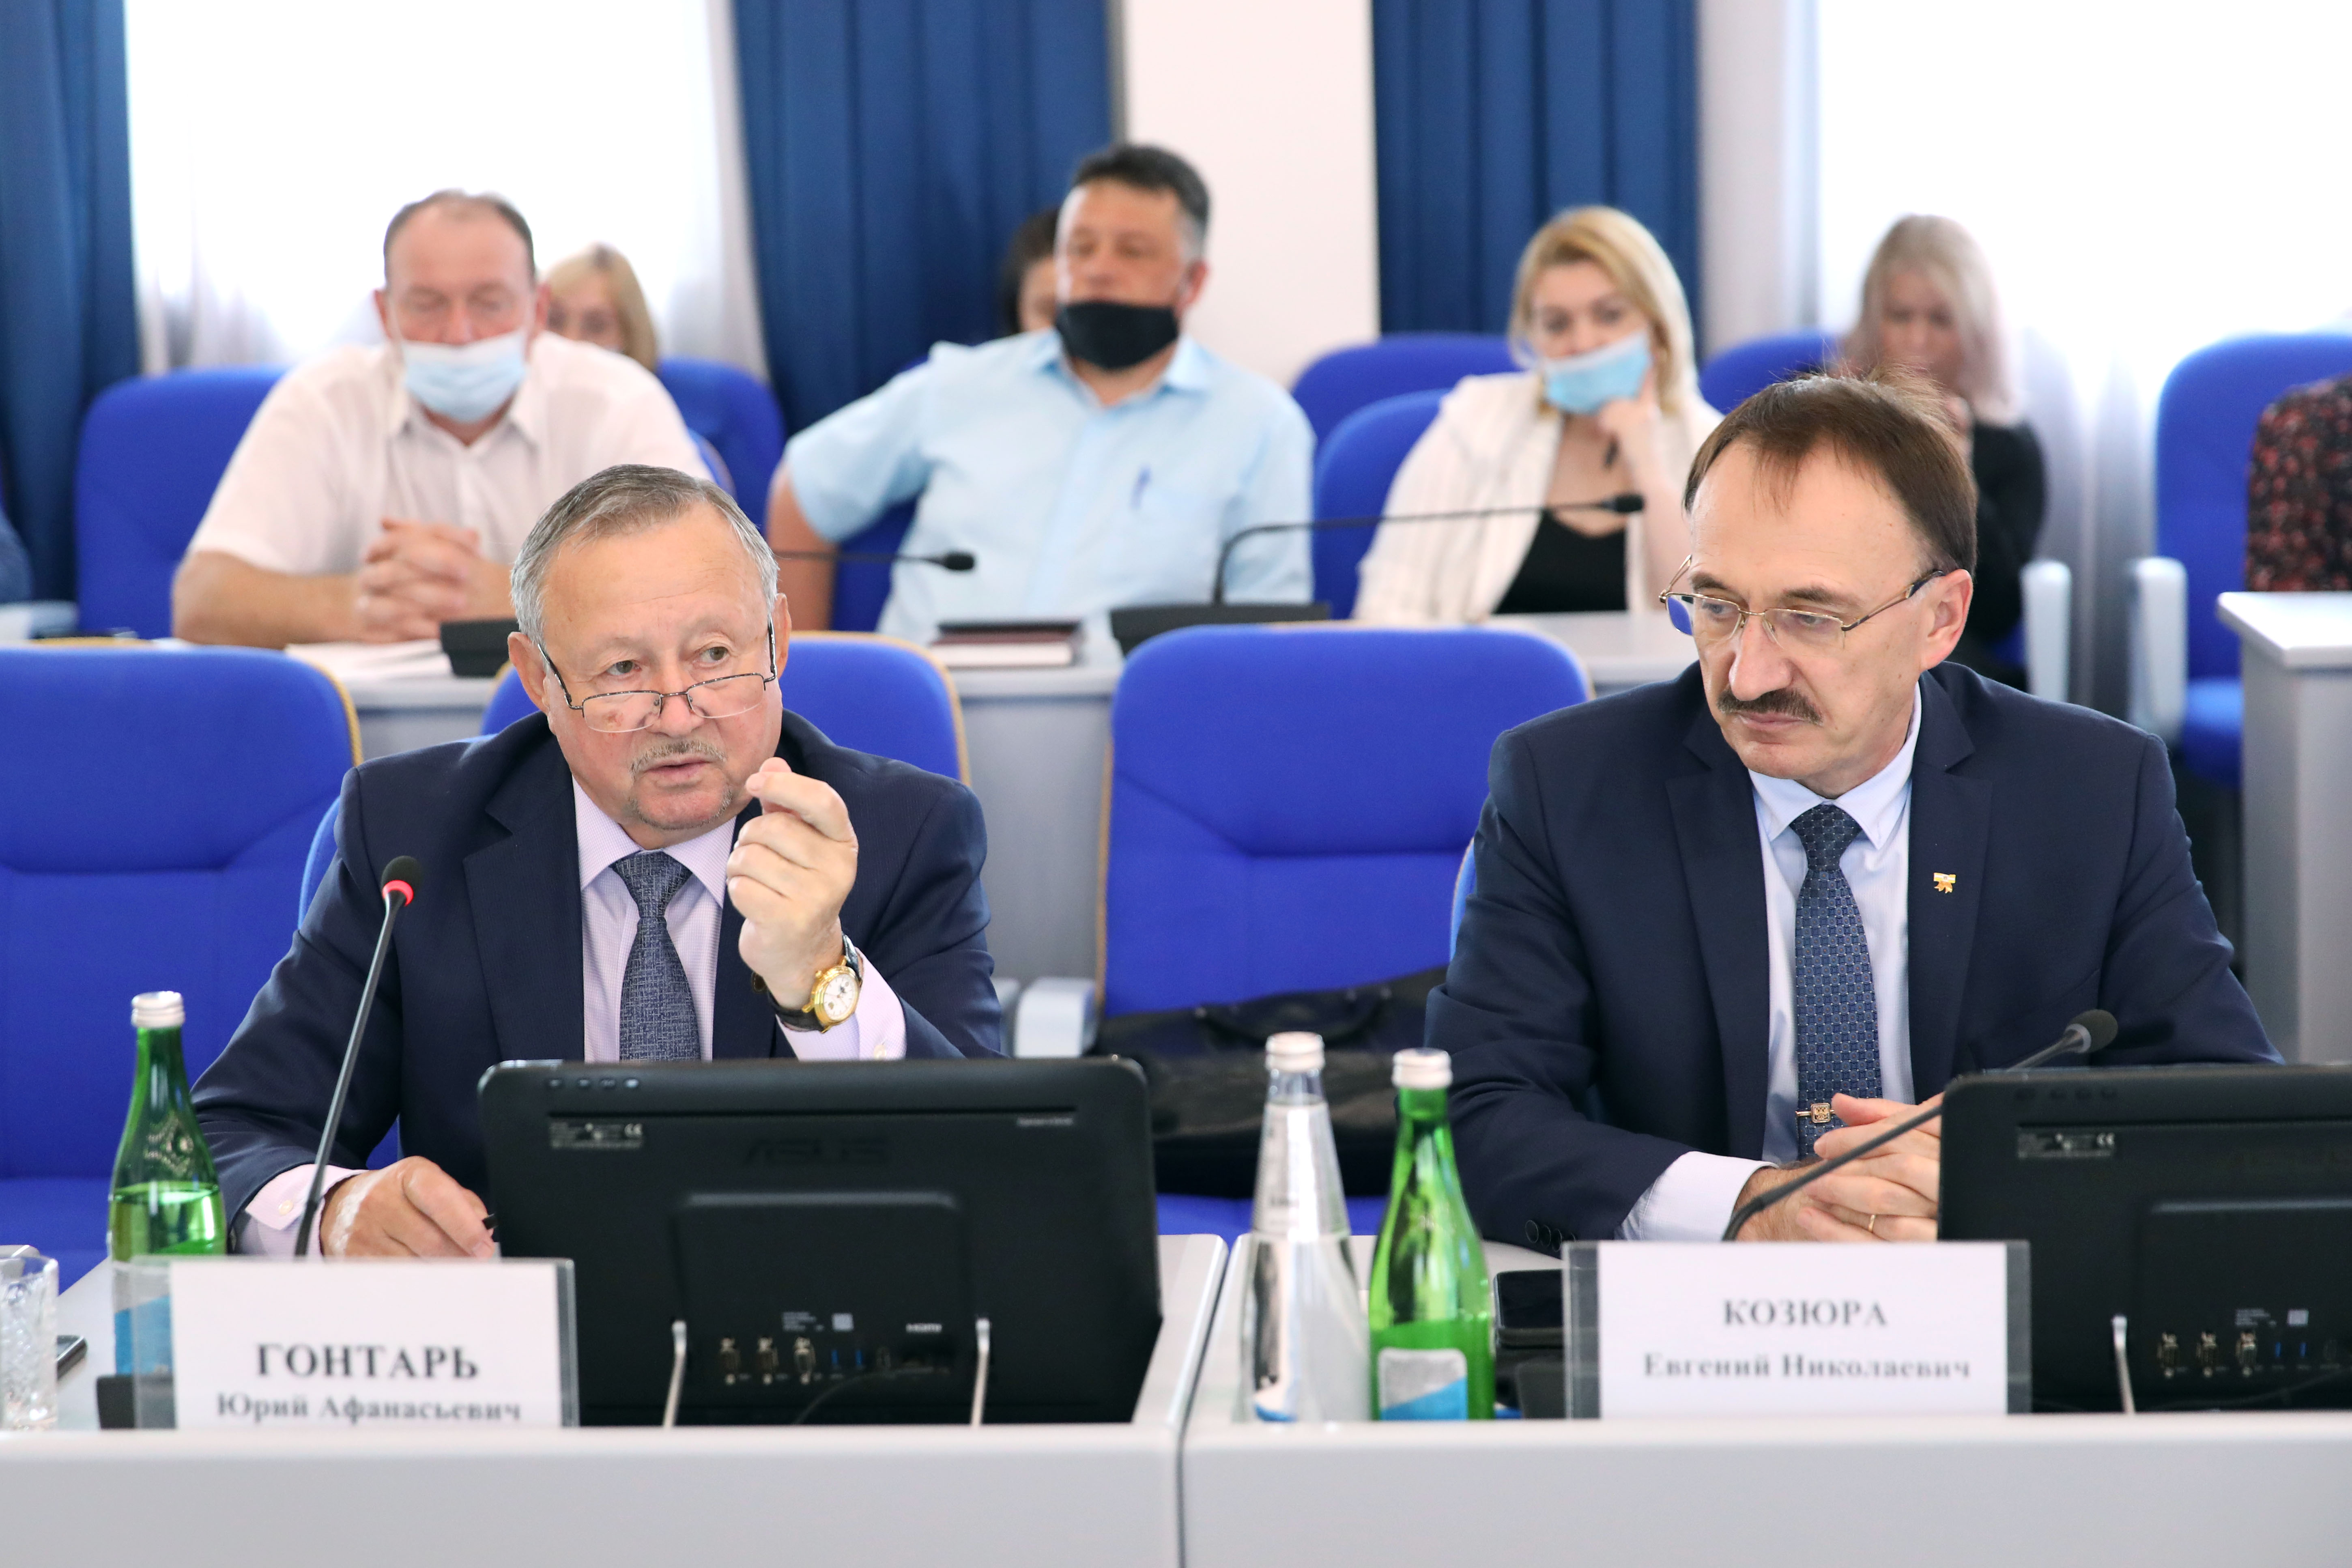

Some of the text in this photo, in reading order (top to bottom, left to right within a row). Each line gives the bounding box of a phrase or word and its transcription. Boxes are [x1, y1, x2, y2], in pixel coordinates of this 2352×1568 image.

[1724, 1299, 1887, 1326] КОЗЮРА
[256, 1344, 479, 1379] ГОНТАРЬ
[1644, 1353, 1970, 1379] Евгений Николаевич
[217, 1393, 522, 1426] Юрий Афанасьевич
